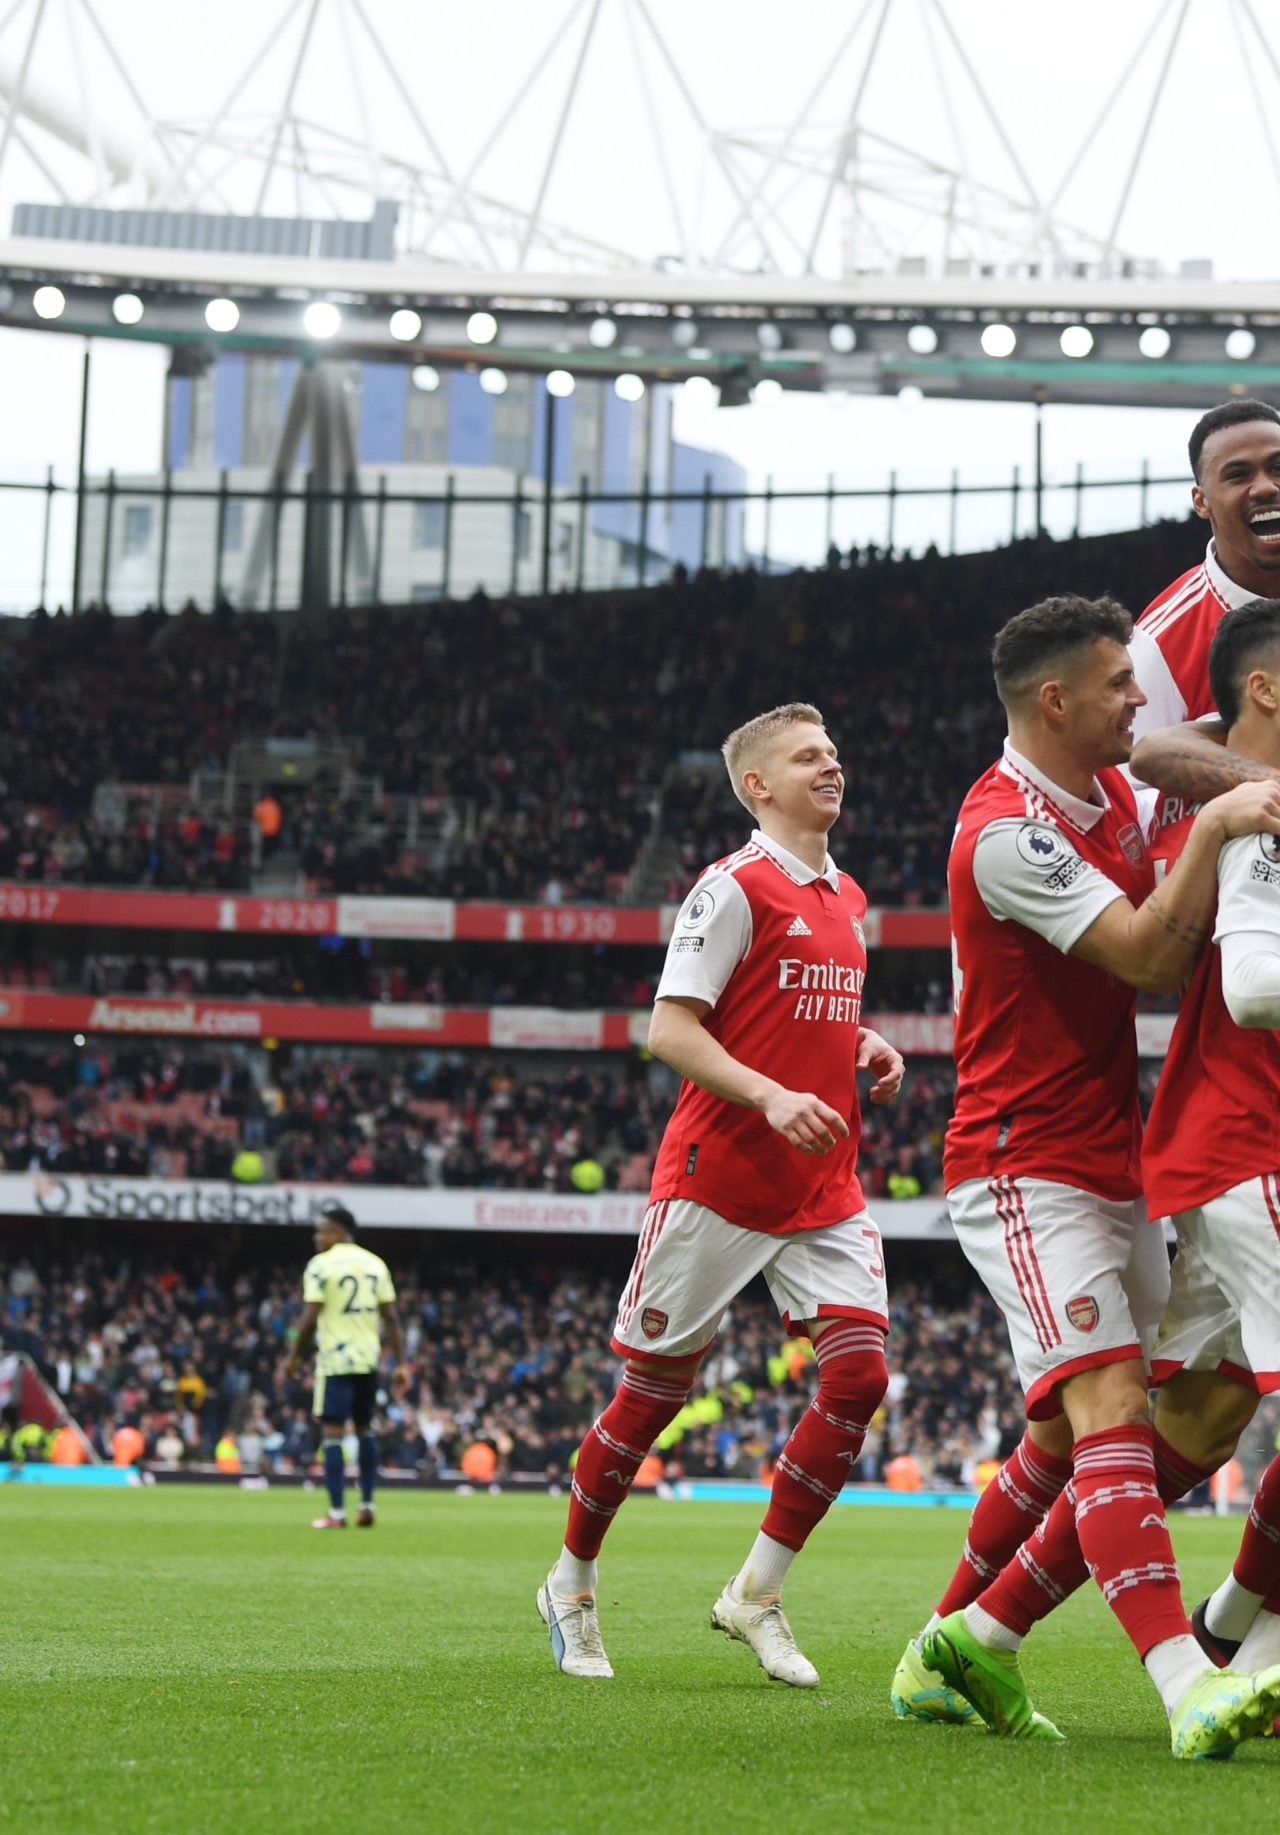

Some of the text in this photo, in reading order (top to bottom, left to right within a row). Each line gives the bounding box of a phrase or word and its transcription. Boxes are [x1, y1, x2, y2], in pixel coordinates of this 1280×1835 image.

[541, 911, 615, 939] 1930
[89, 1000, 261, 1036] Arsenal.com
[793, 994, 825, 1020] FLY
